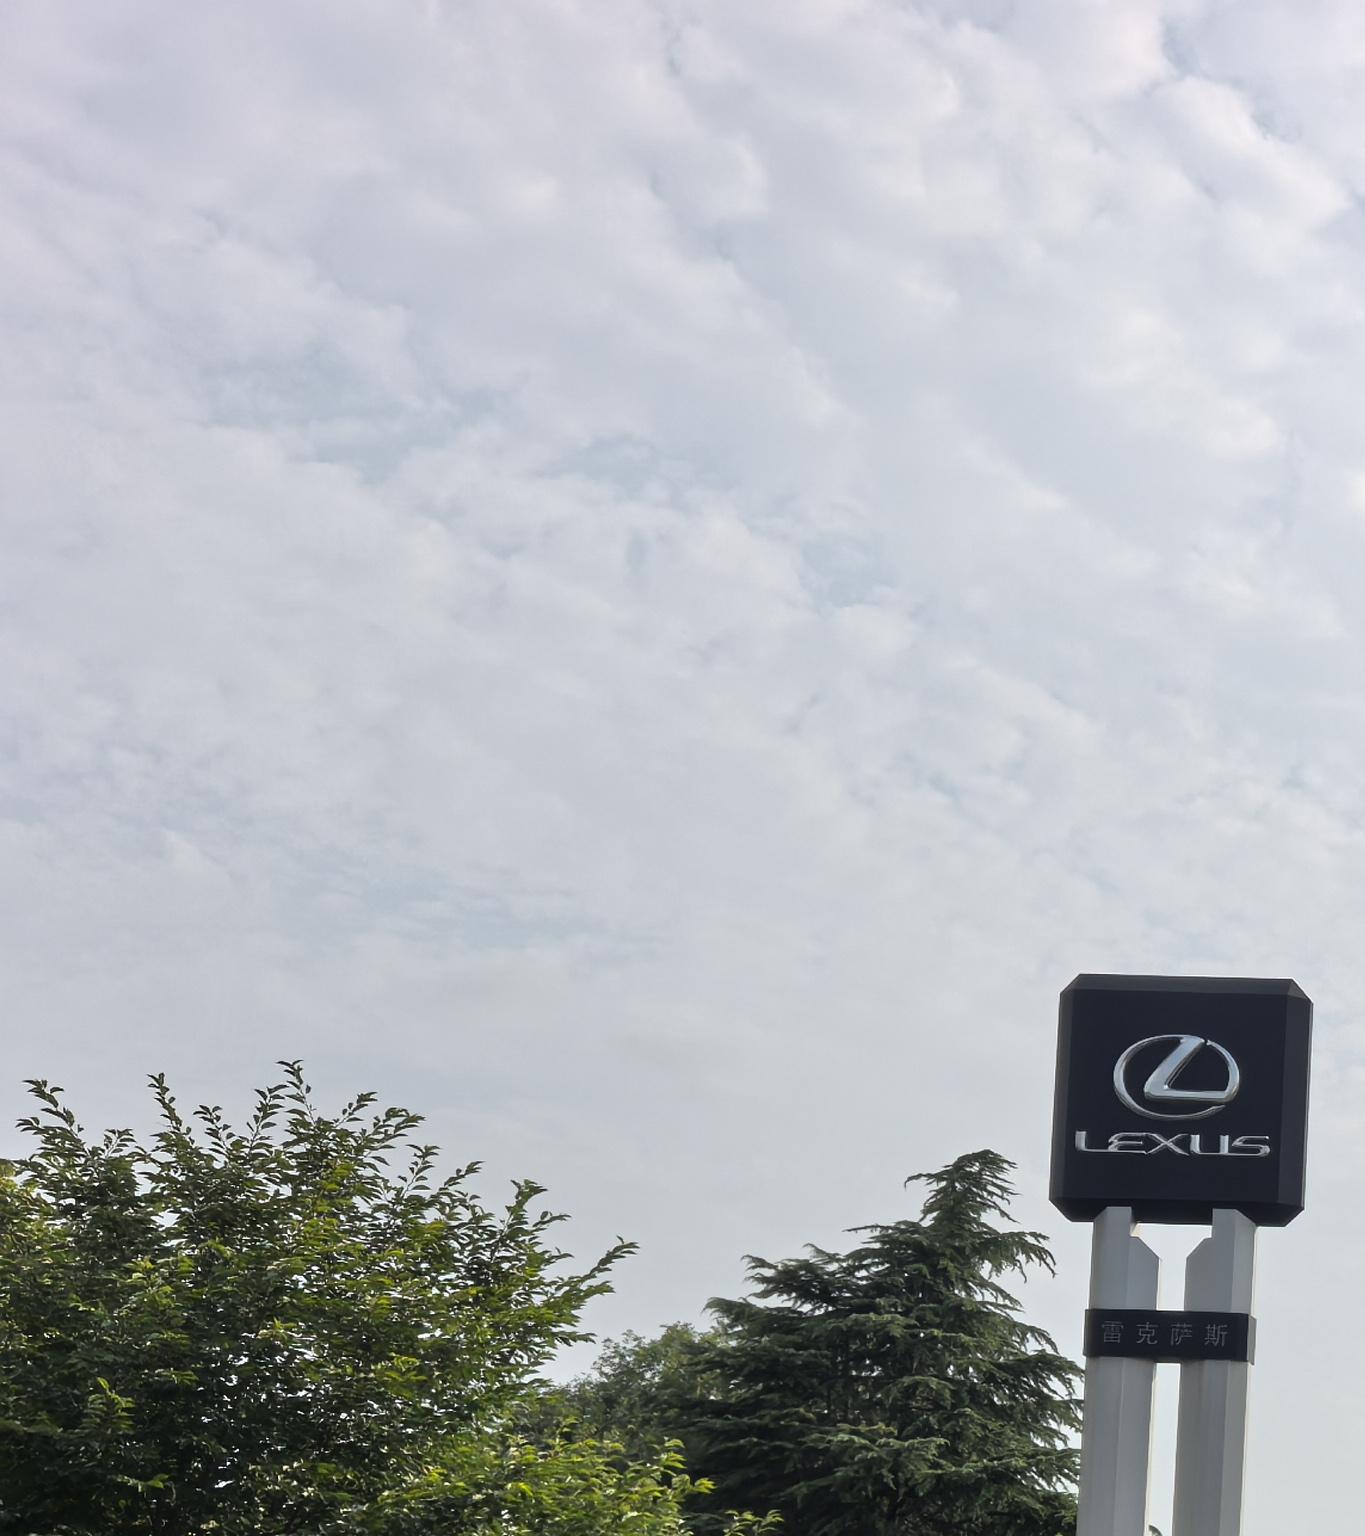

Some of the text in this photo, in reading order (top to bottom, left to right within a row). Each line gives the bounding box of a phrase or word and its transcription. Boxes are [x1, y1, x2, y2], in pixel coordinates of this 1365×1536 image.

[1075, 1130, 1270, 1156] LEXUS
[1101, 1320, 1228, 1347] 雷克萨斯
